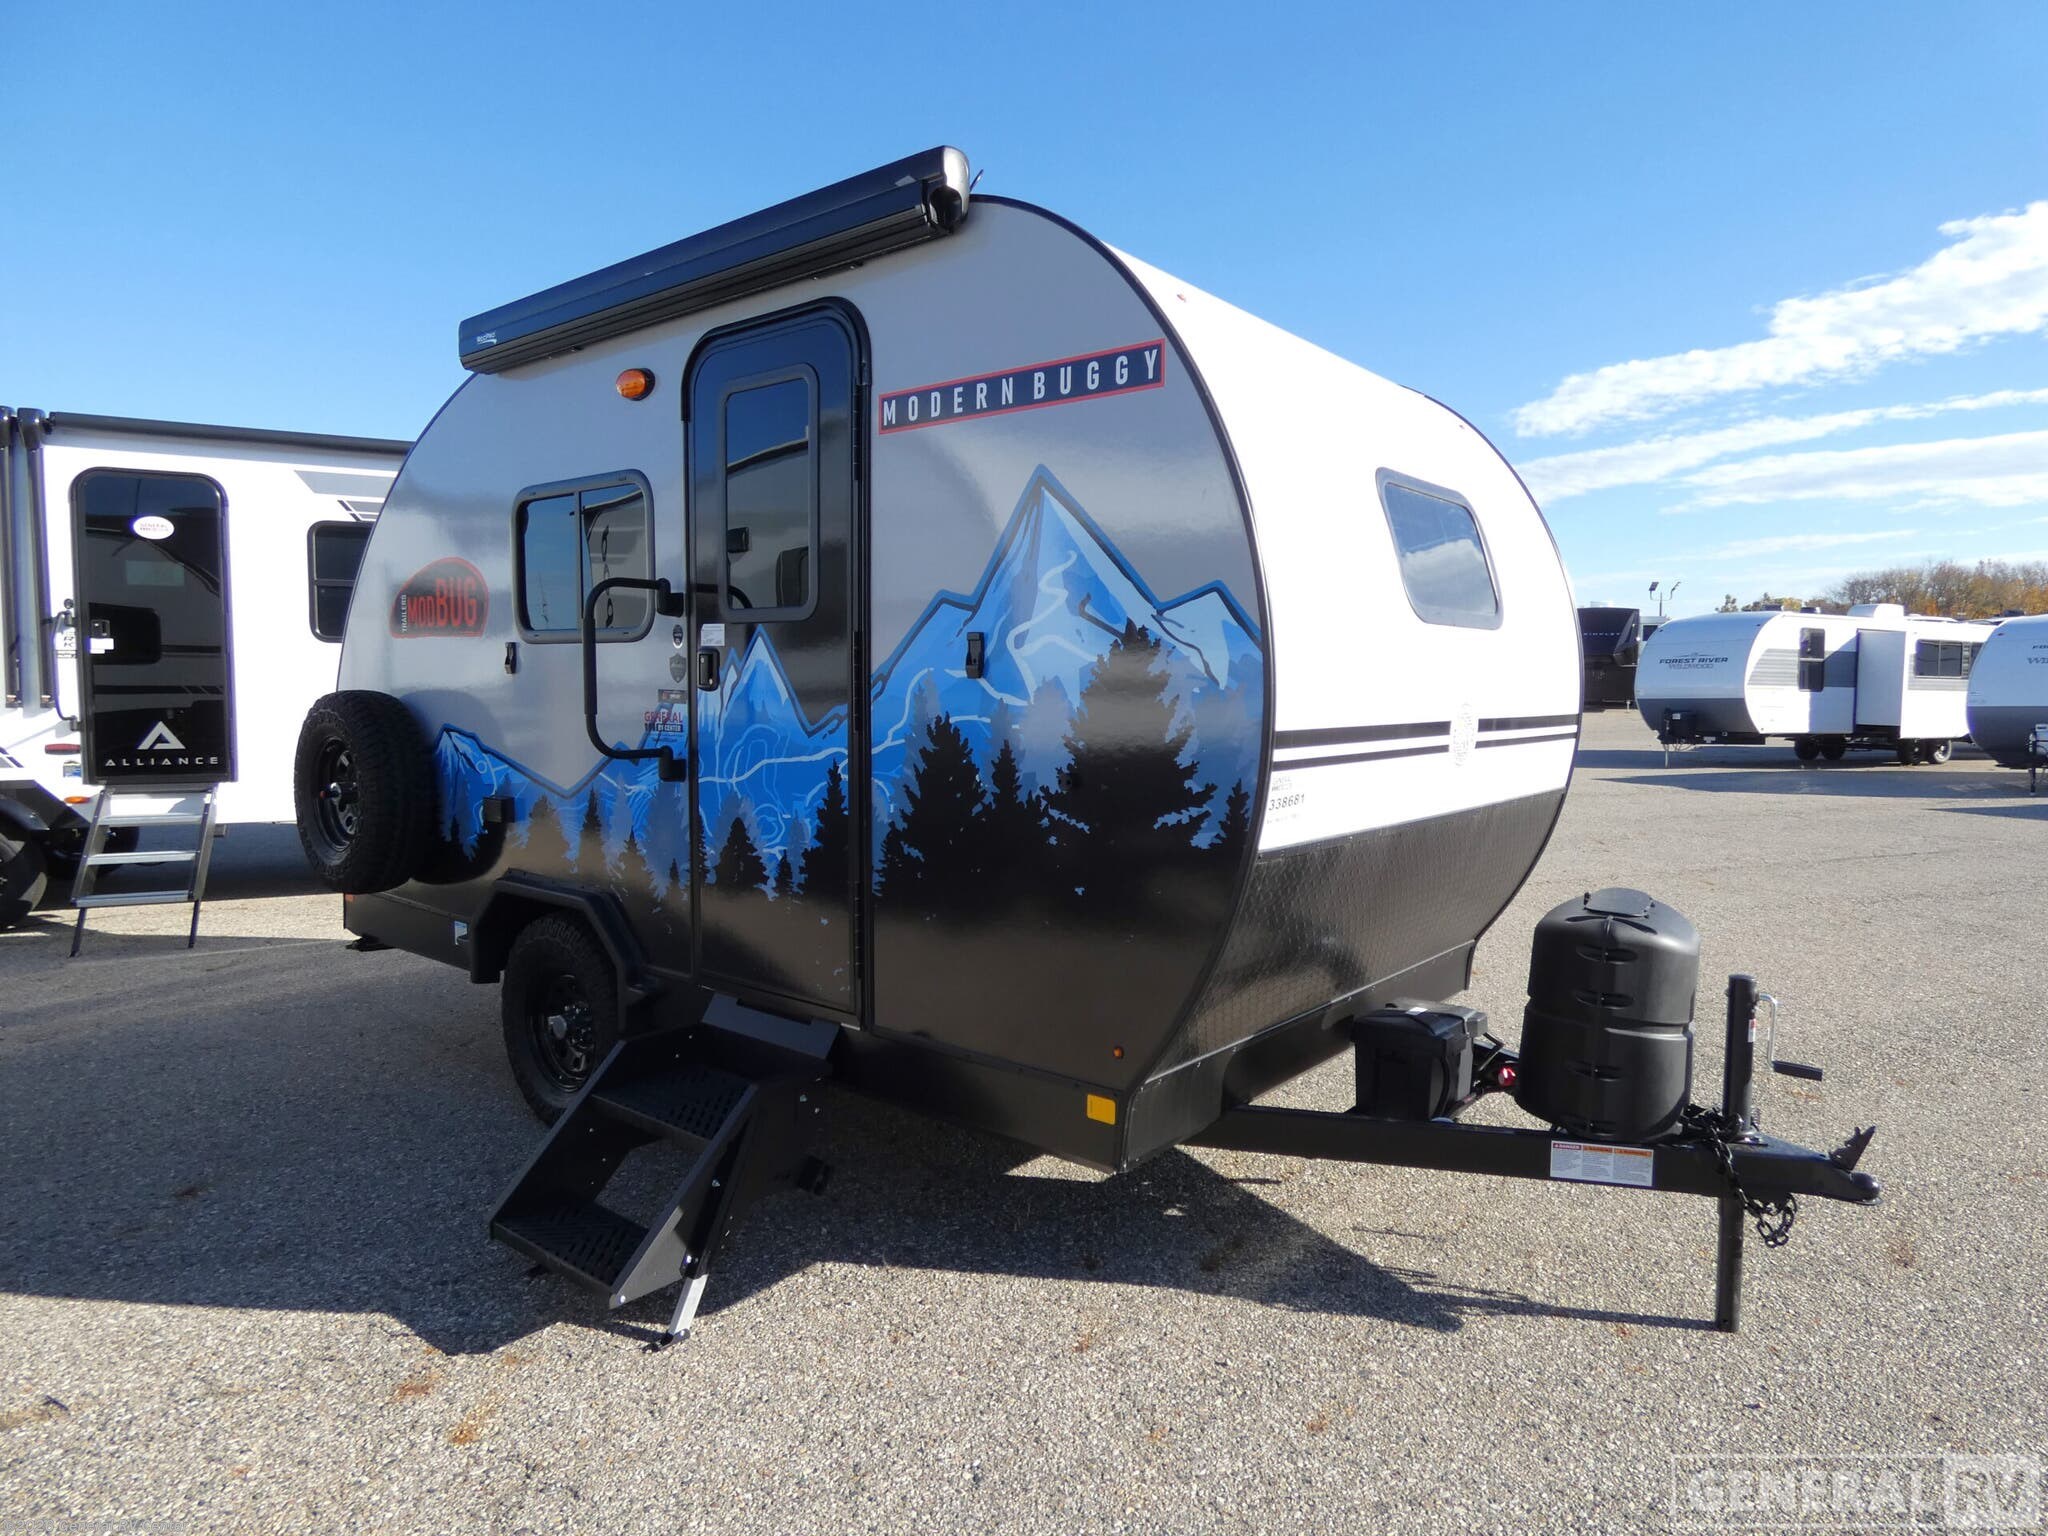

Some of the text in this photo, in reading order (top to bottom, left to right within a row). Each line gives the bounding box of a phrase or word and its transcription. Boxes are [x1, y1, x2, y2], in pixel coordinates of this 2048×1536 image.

[883, 349, 1158, 426] MODERN BUGGY
[105, 756, 219, 767] ALLIANCE
[1268, 793, 1305, 811] 338681
